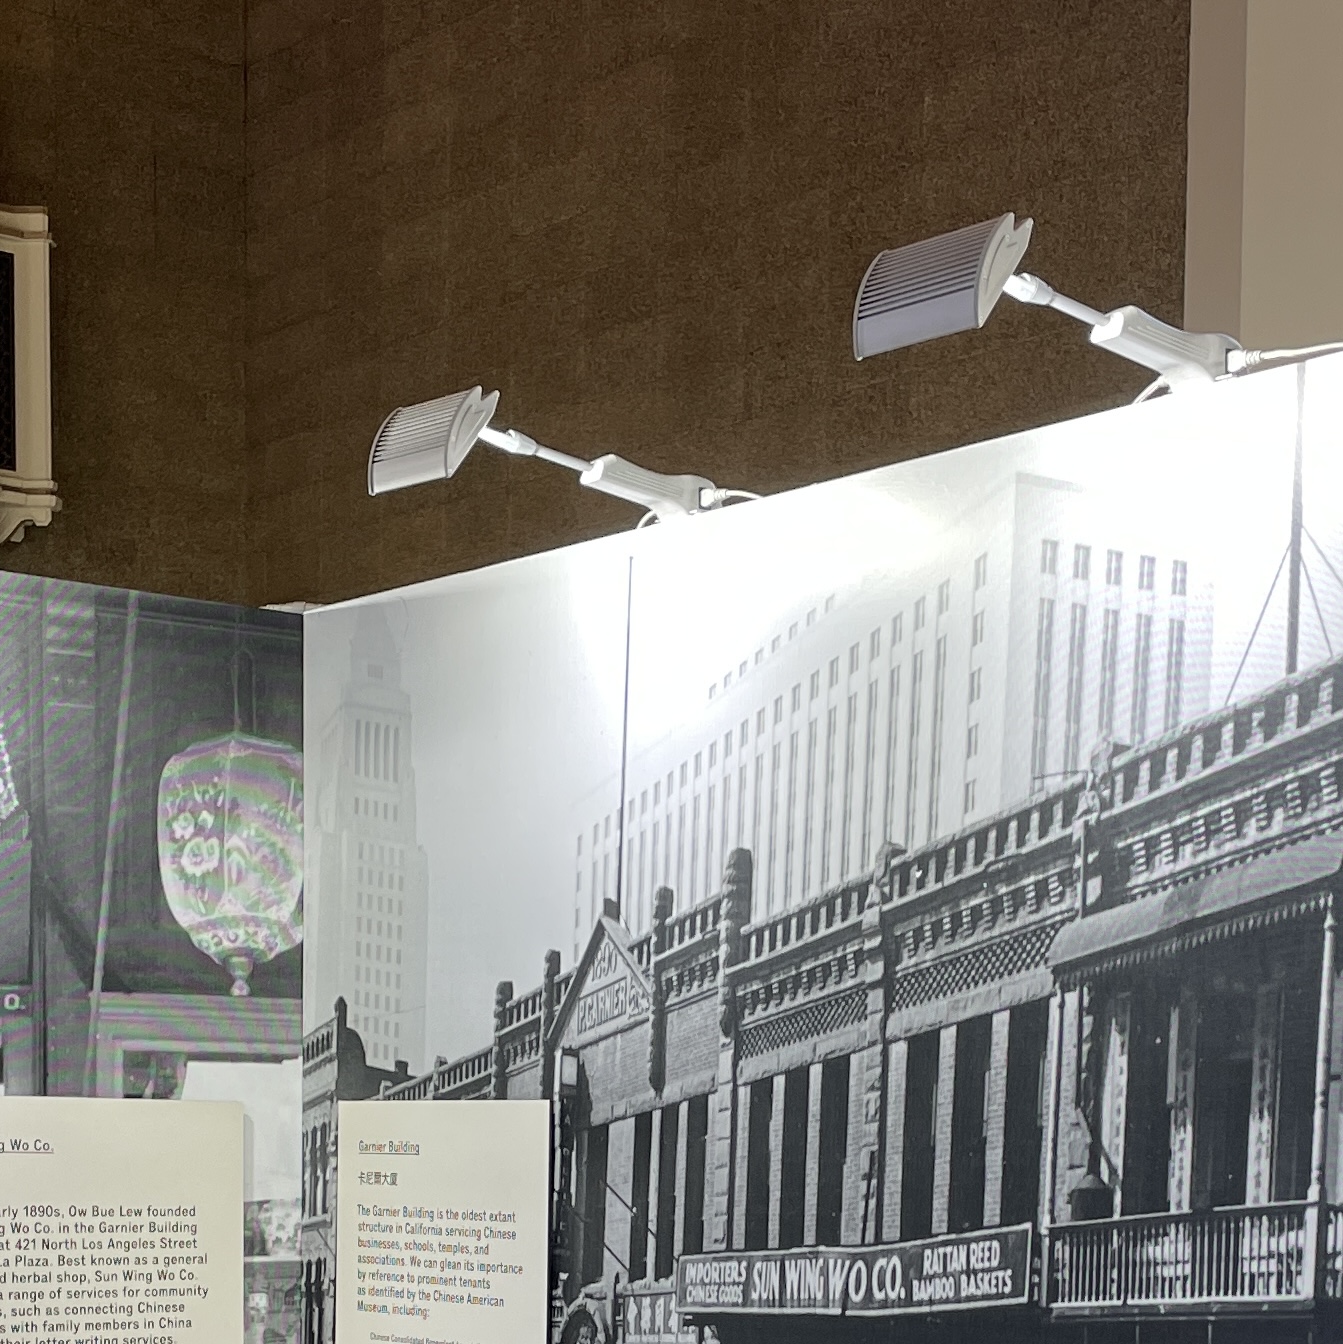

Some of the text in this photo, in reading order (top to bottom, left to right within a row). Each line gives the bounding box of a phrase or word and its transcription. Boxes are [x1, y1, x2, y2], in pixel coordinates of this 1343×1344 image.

[9, 1138, 29, 1151] Wo
[33, 1139, 54, 1152] Co.
[358, 1140, 420, 1155] Garnier Building
[22, 1204, 64, 1218] 1890s,
[68, 1204, 87, 1217] Ow
[91, 1205, 115, 1217] Bue
[119, 1205, 142, 1217] Lew
[146, 1204, 196, 1217] founded
[356, 1203, 516, 1223] The Garnier Building is the oldest extant
[9, 1221, 30, 1234] Wo
[34, 1221, 54, 1234] Co.
[58, 1222, 70, 1233] in
[74, 1221, 94, 1233] the
[98, 1221, 144, 1233] Garnier
[148, 1221, 197, 1235] Building
[357, 1221, 517, 1241] structure in California servicing Chinese
[14, 1238, 36, 1250] 421
[41, 1238, 77, 1250] North
[81, 1238, 103, 1250] Los
[107, 1237, 156, 1252] Angeles
[159, 1237, 198, 1249] Street
[14, 1254, 53, 1267] Plaza.
[57, 1254, 86, 1266] Best
[90, 1254, 130, 1266] known
[134, 1256, 148, 1265] as
[152, 1256, 159, 1265] a
[163, 1253, 208, 1268] general
[922, 1240, 1001, 1276] RATTAN REED
[685, 1261, 747, 1284] IMPORTERS
[751, 1255, 906, 1303] SUN WING WO CO.
[912, 1269, 1013, 1302] BAMBOO BASKETS
